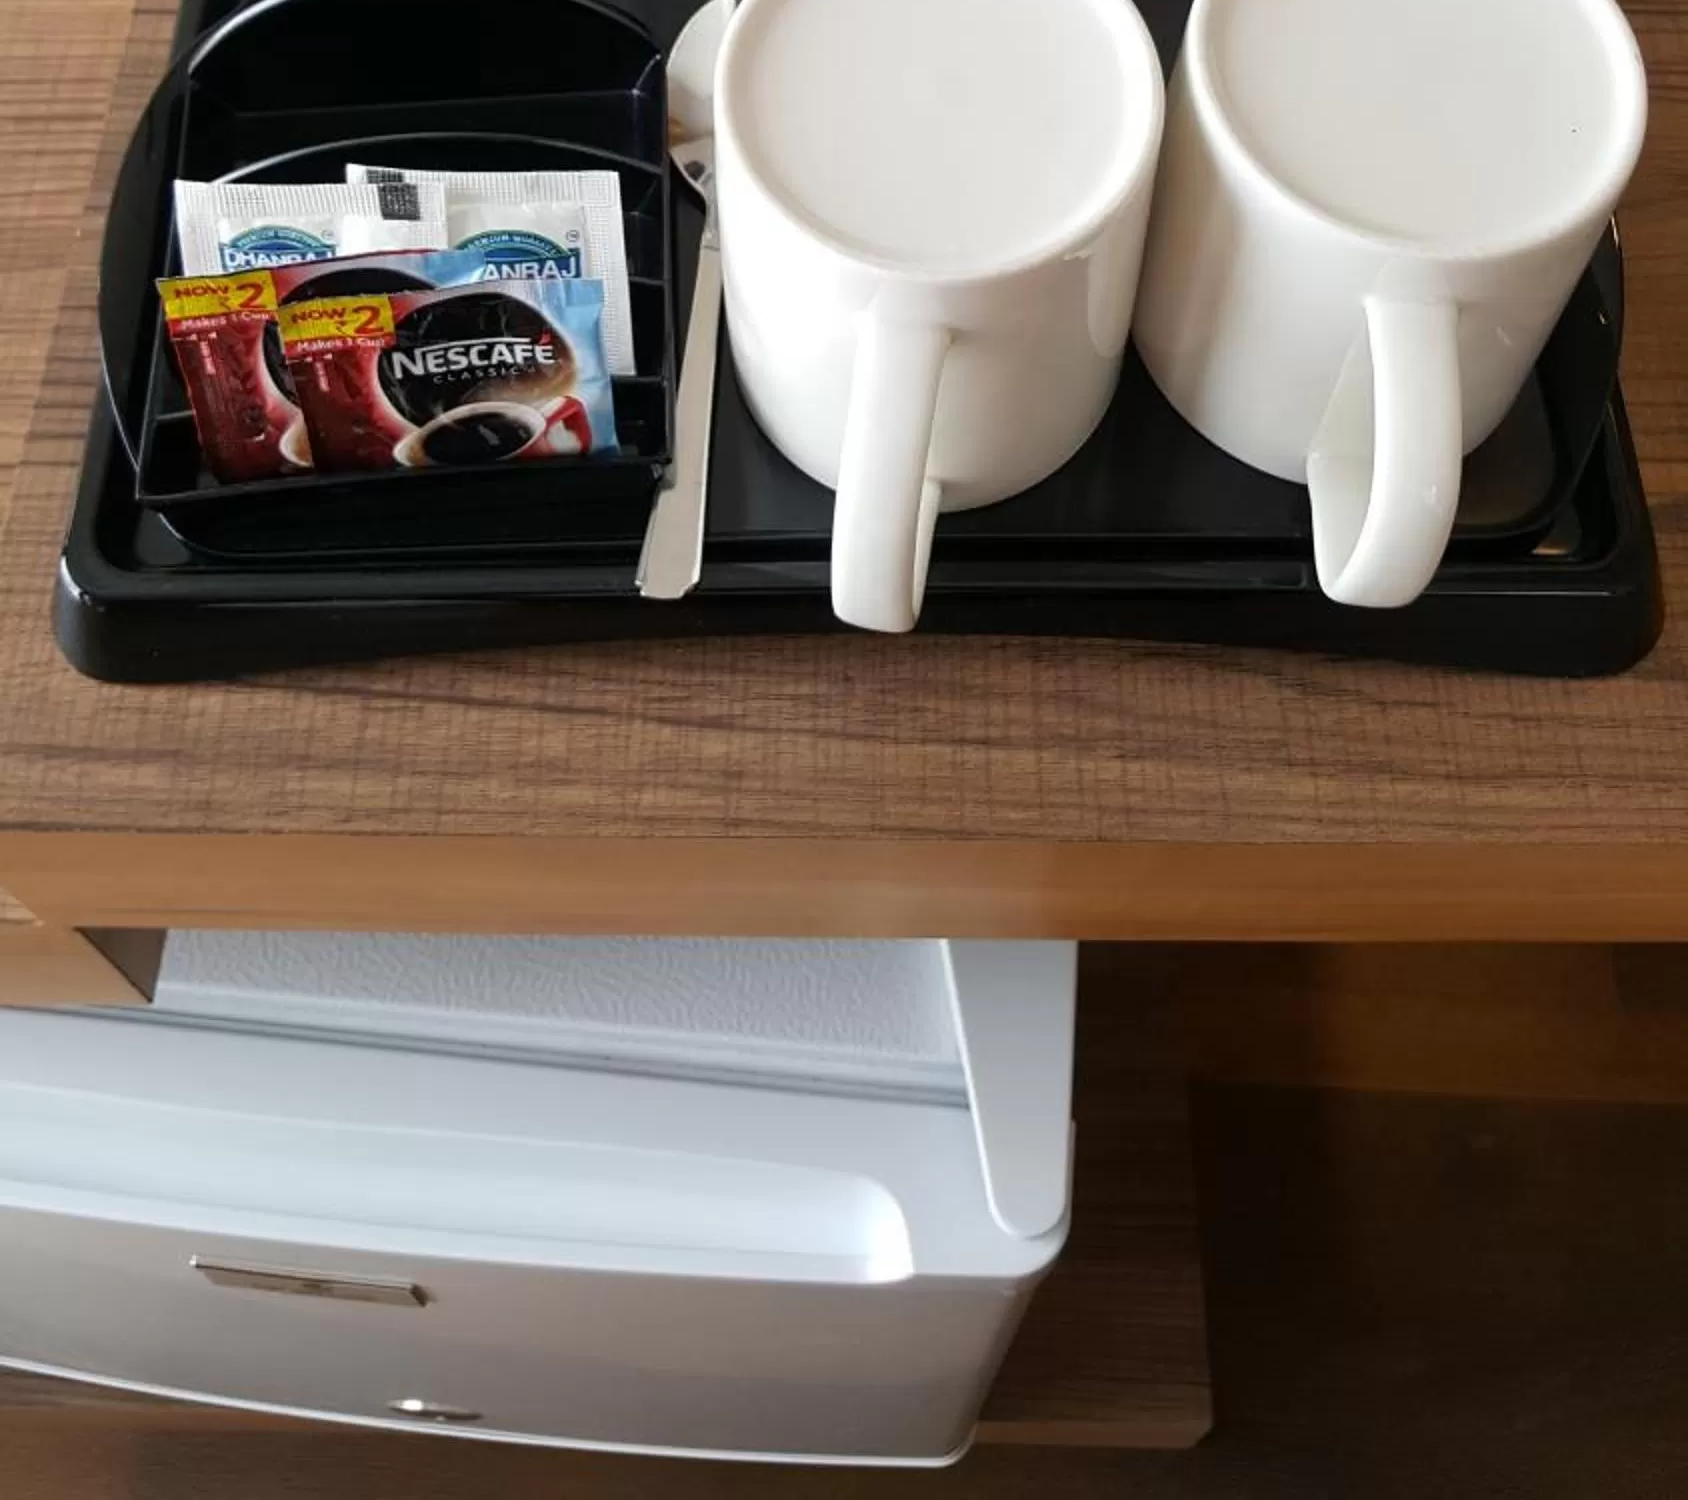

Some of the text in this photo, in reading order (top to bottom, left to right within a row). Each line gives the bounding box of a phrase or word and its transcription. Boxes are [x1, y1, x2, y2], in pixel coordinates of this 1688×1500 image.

[484, 256, 577, 279] ANRAJ
[174, 285, 229, 298] NOW
[181, 316, 226, 331] Makes
[291, 307, 346, 324] NOW
[297, 337, 342, 353] Makes
[432, 364, 522, 385] CLASSIC
